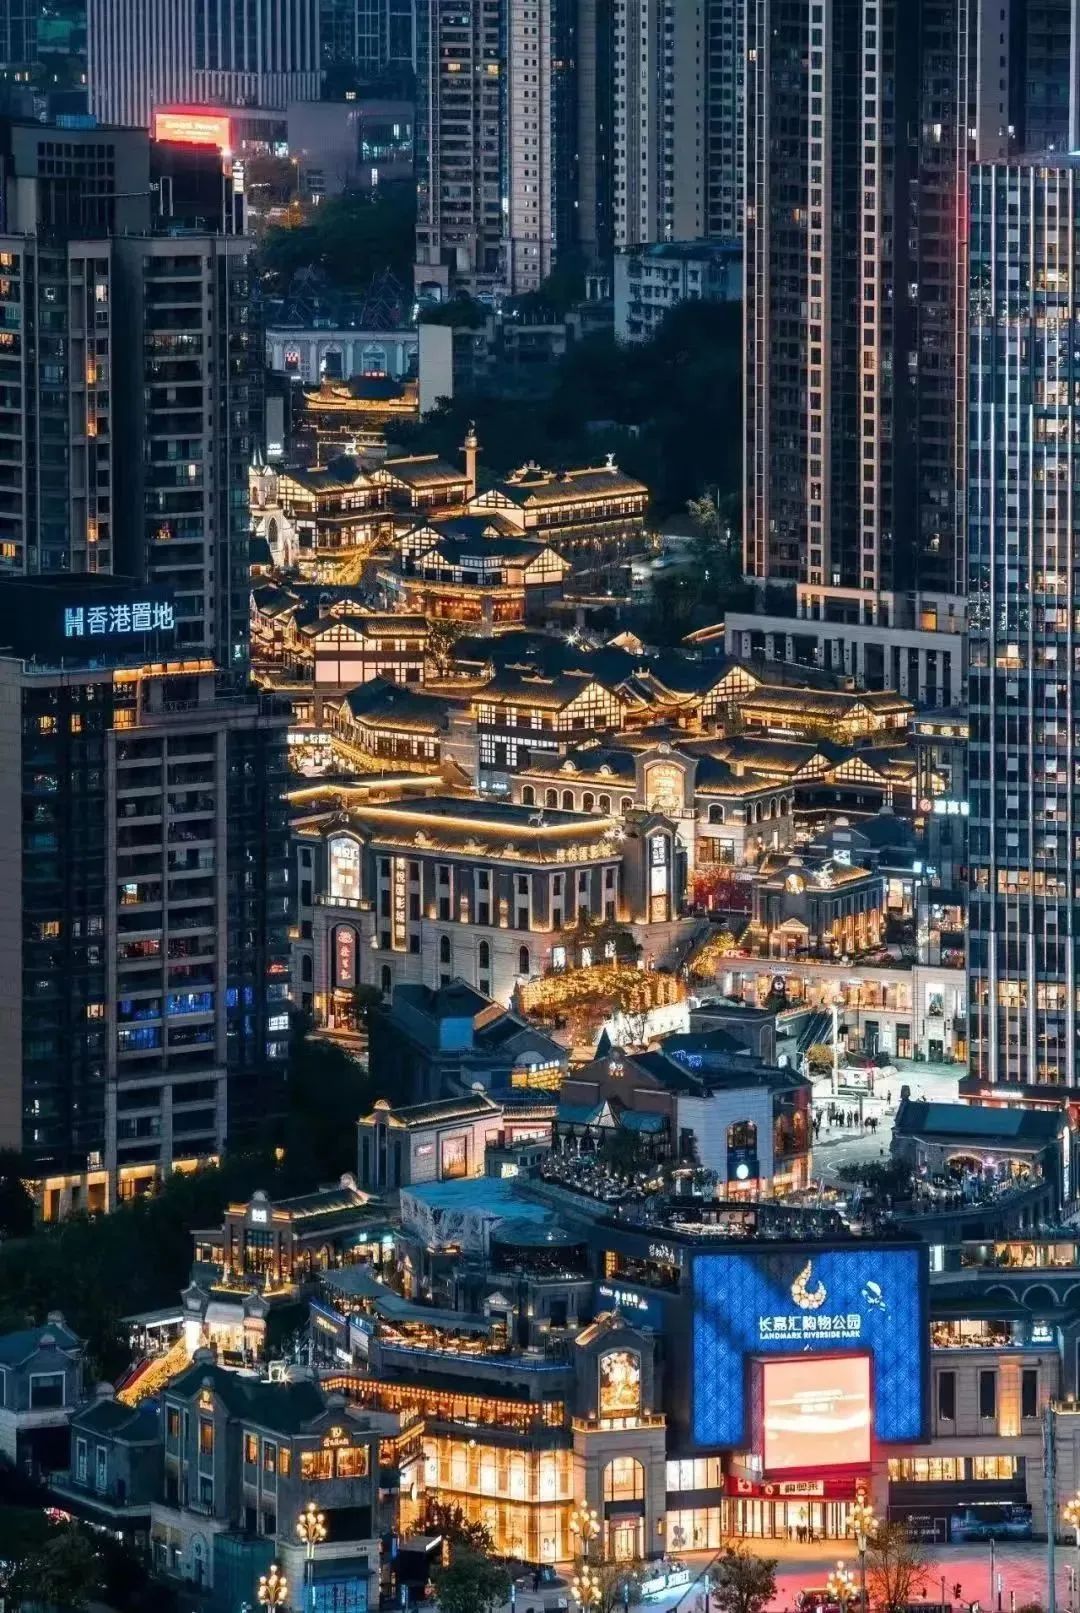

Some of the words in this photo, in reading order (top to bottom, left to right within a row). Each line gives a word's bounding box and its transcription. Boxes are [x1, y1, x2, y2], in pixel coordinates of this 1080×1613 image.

[87, 602, 175, 634] 香港置地
[759, 1314, 861, 1331] 长嘉汇购物公园
[760, 1331, 801, 1339] LANDMARK
[804, 1331, 840, 1339] RIVERSIDE
[842, 1330, 860, 1338] PARK
